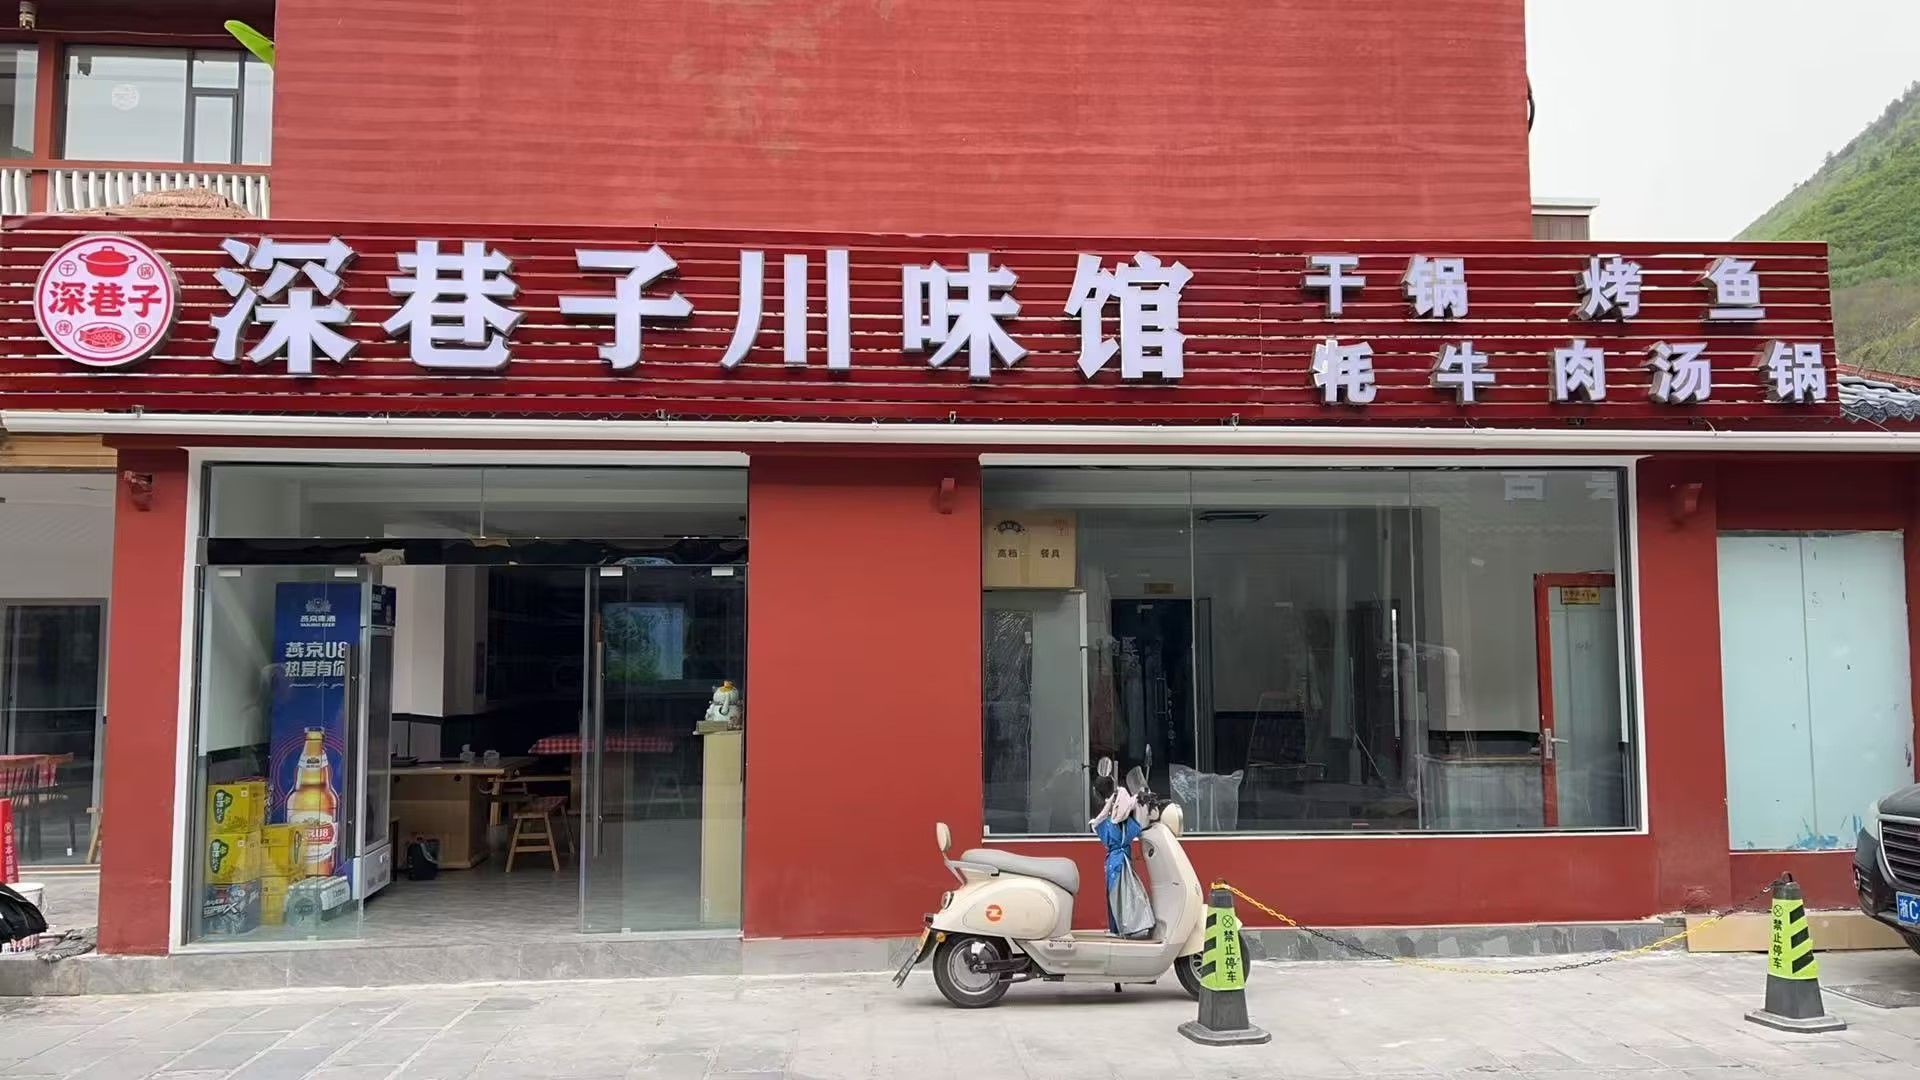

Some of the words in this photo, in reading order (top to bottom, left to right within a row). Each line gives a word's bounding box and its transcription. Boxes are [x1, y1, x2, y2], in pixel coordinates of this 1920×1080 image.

[62, 264, 74, 274] 干
[1303, 254, 1468, 319] 干锅
[1578, 255, 1766, 319] 烤鱼
[48, 281, 162, 318] 深巷子
[210, 236, 1194, 381] 深巷子川味馆
[1312, 338, 1827, 404] 牦牛肉汤锅
[285, 641, 348, 658] 燕京U8
[1899, 899, 1920, 920] 浙C
[1224, 930, 1237, 982] 禁止停车
[1773, 919, 1783, 969] 禁止停车
